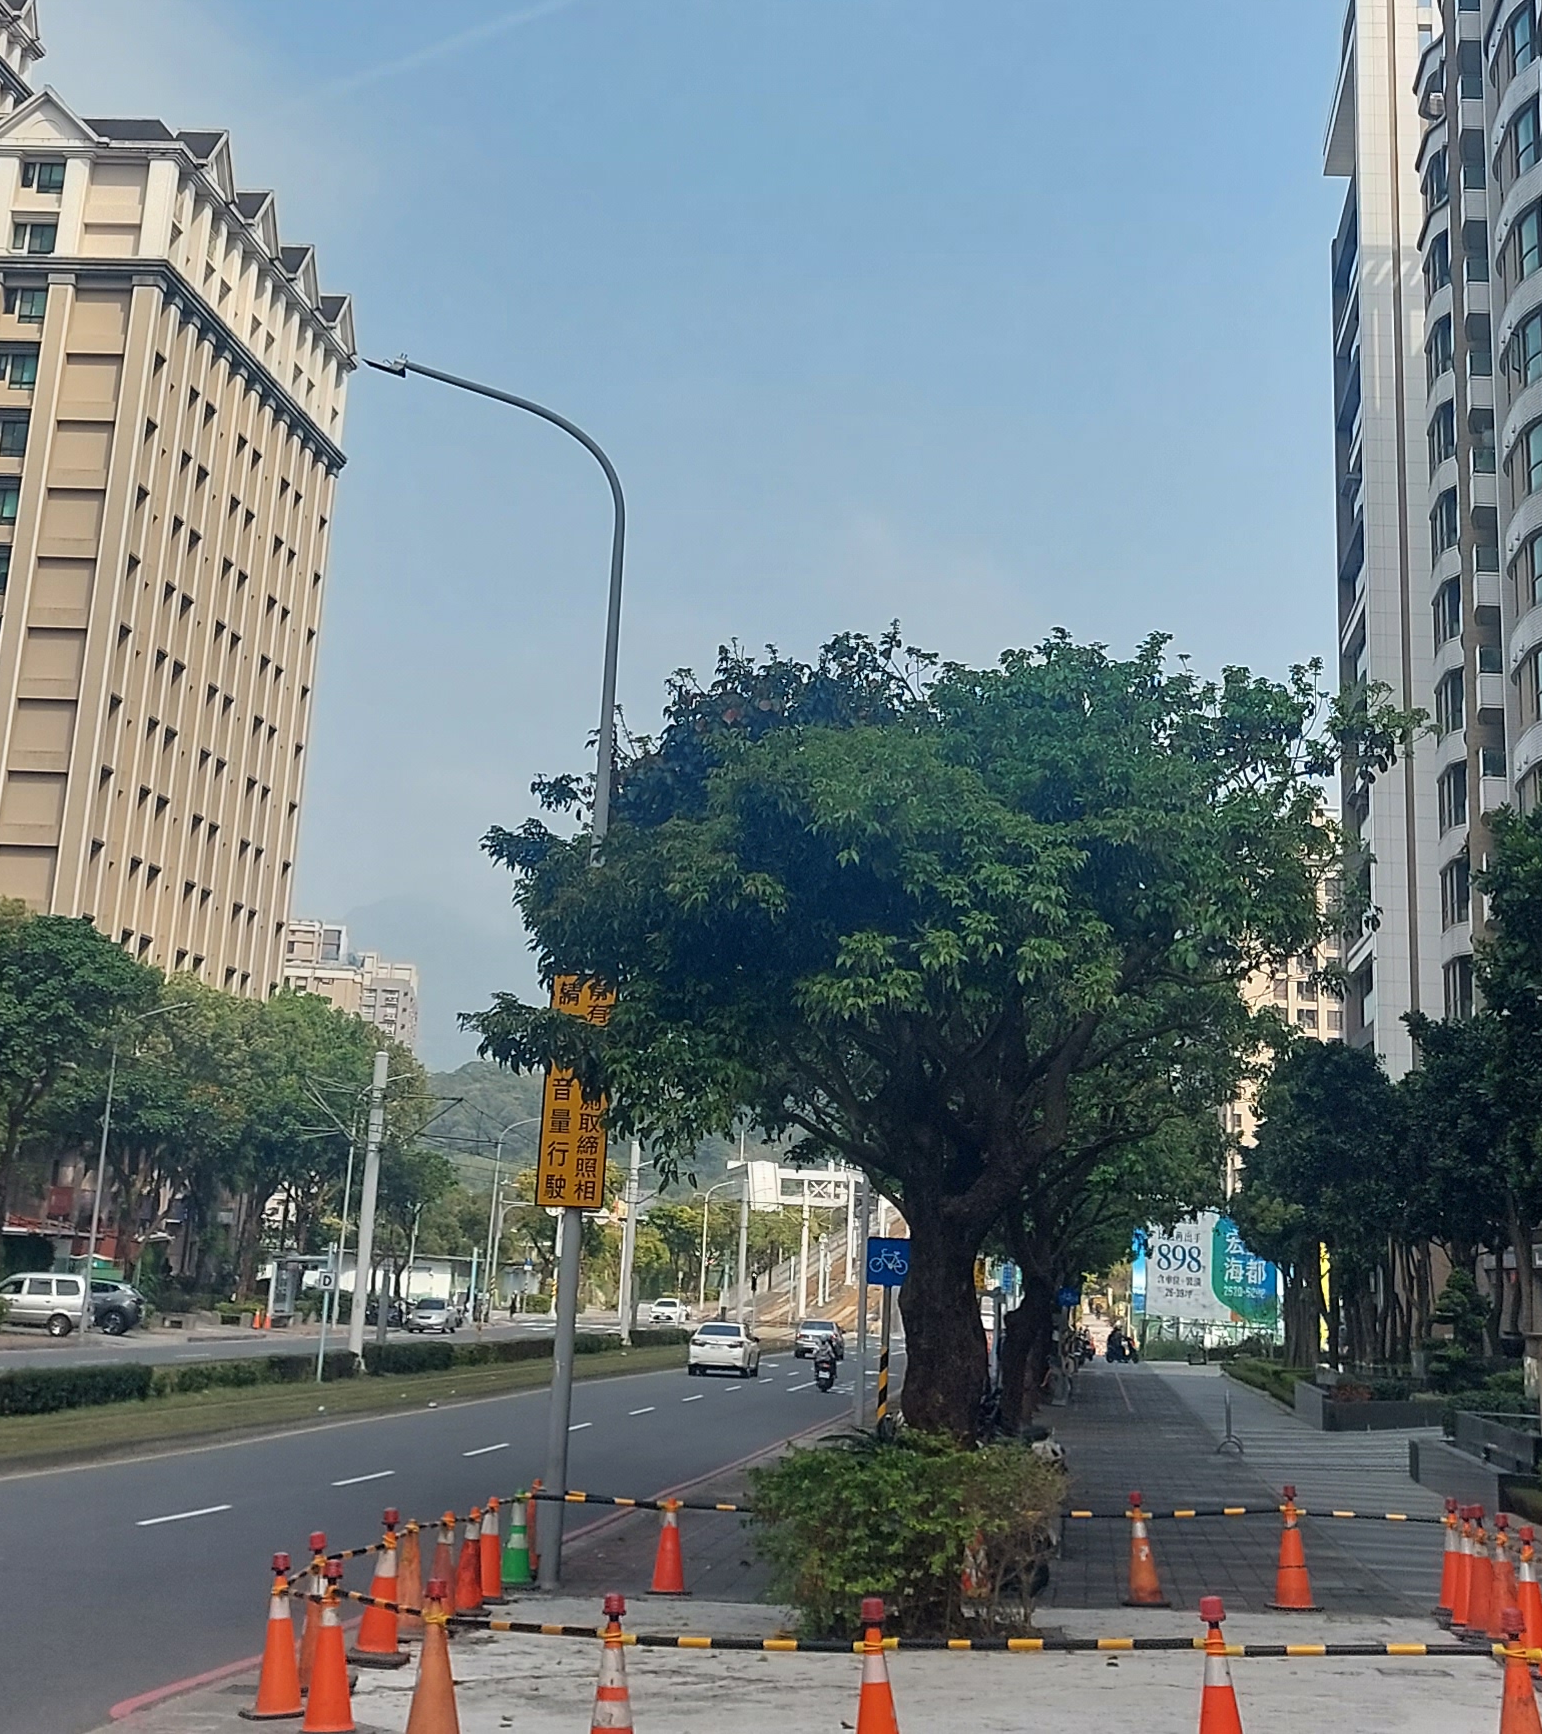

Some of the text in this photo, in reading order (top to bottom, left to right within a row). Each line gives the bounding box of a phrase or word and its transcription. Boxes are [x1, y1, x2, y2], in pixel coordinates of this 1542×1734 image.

[1157, 1243, 1202, 1273] 898
[1223, 1257, 1267, 1285] 海都
[322, 1275, 332, 1287] D
